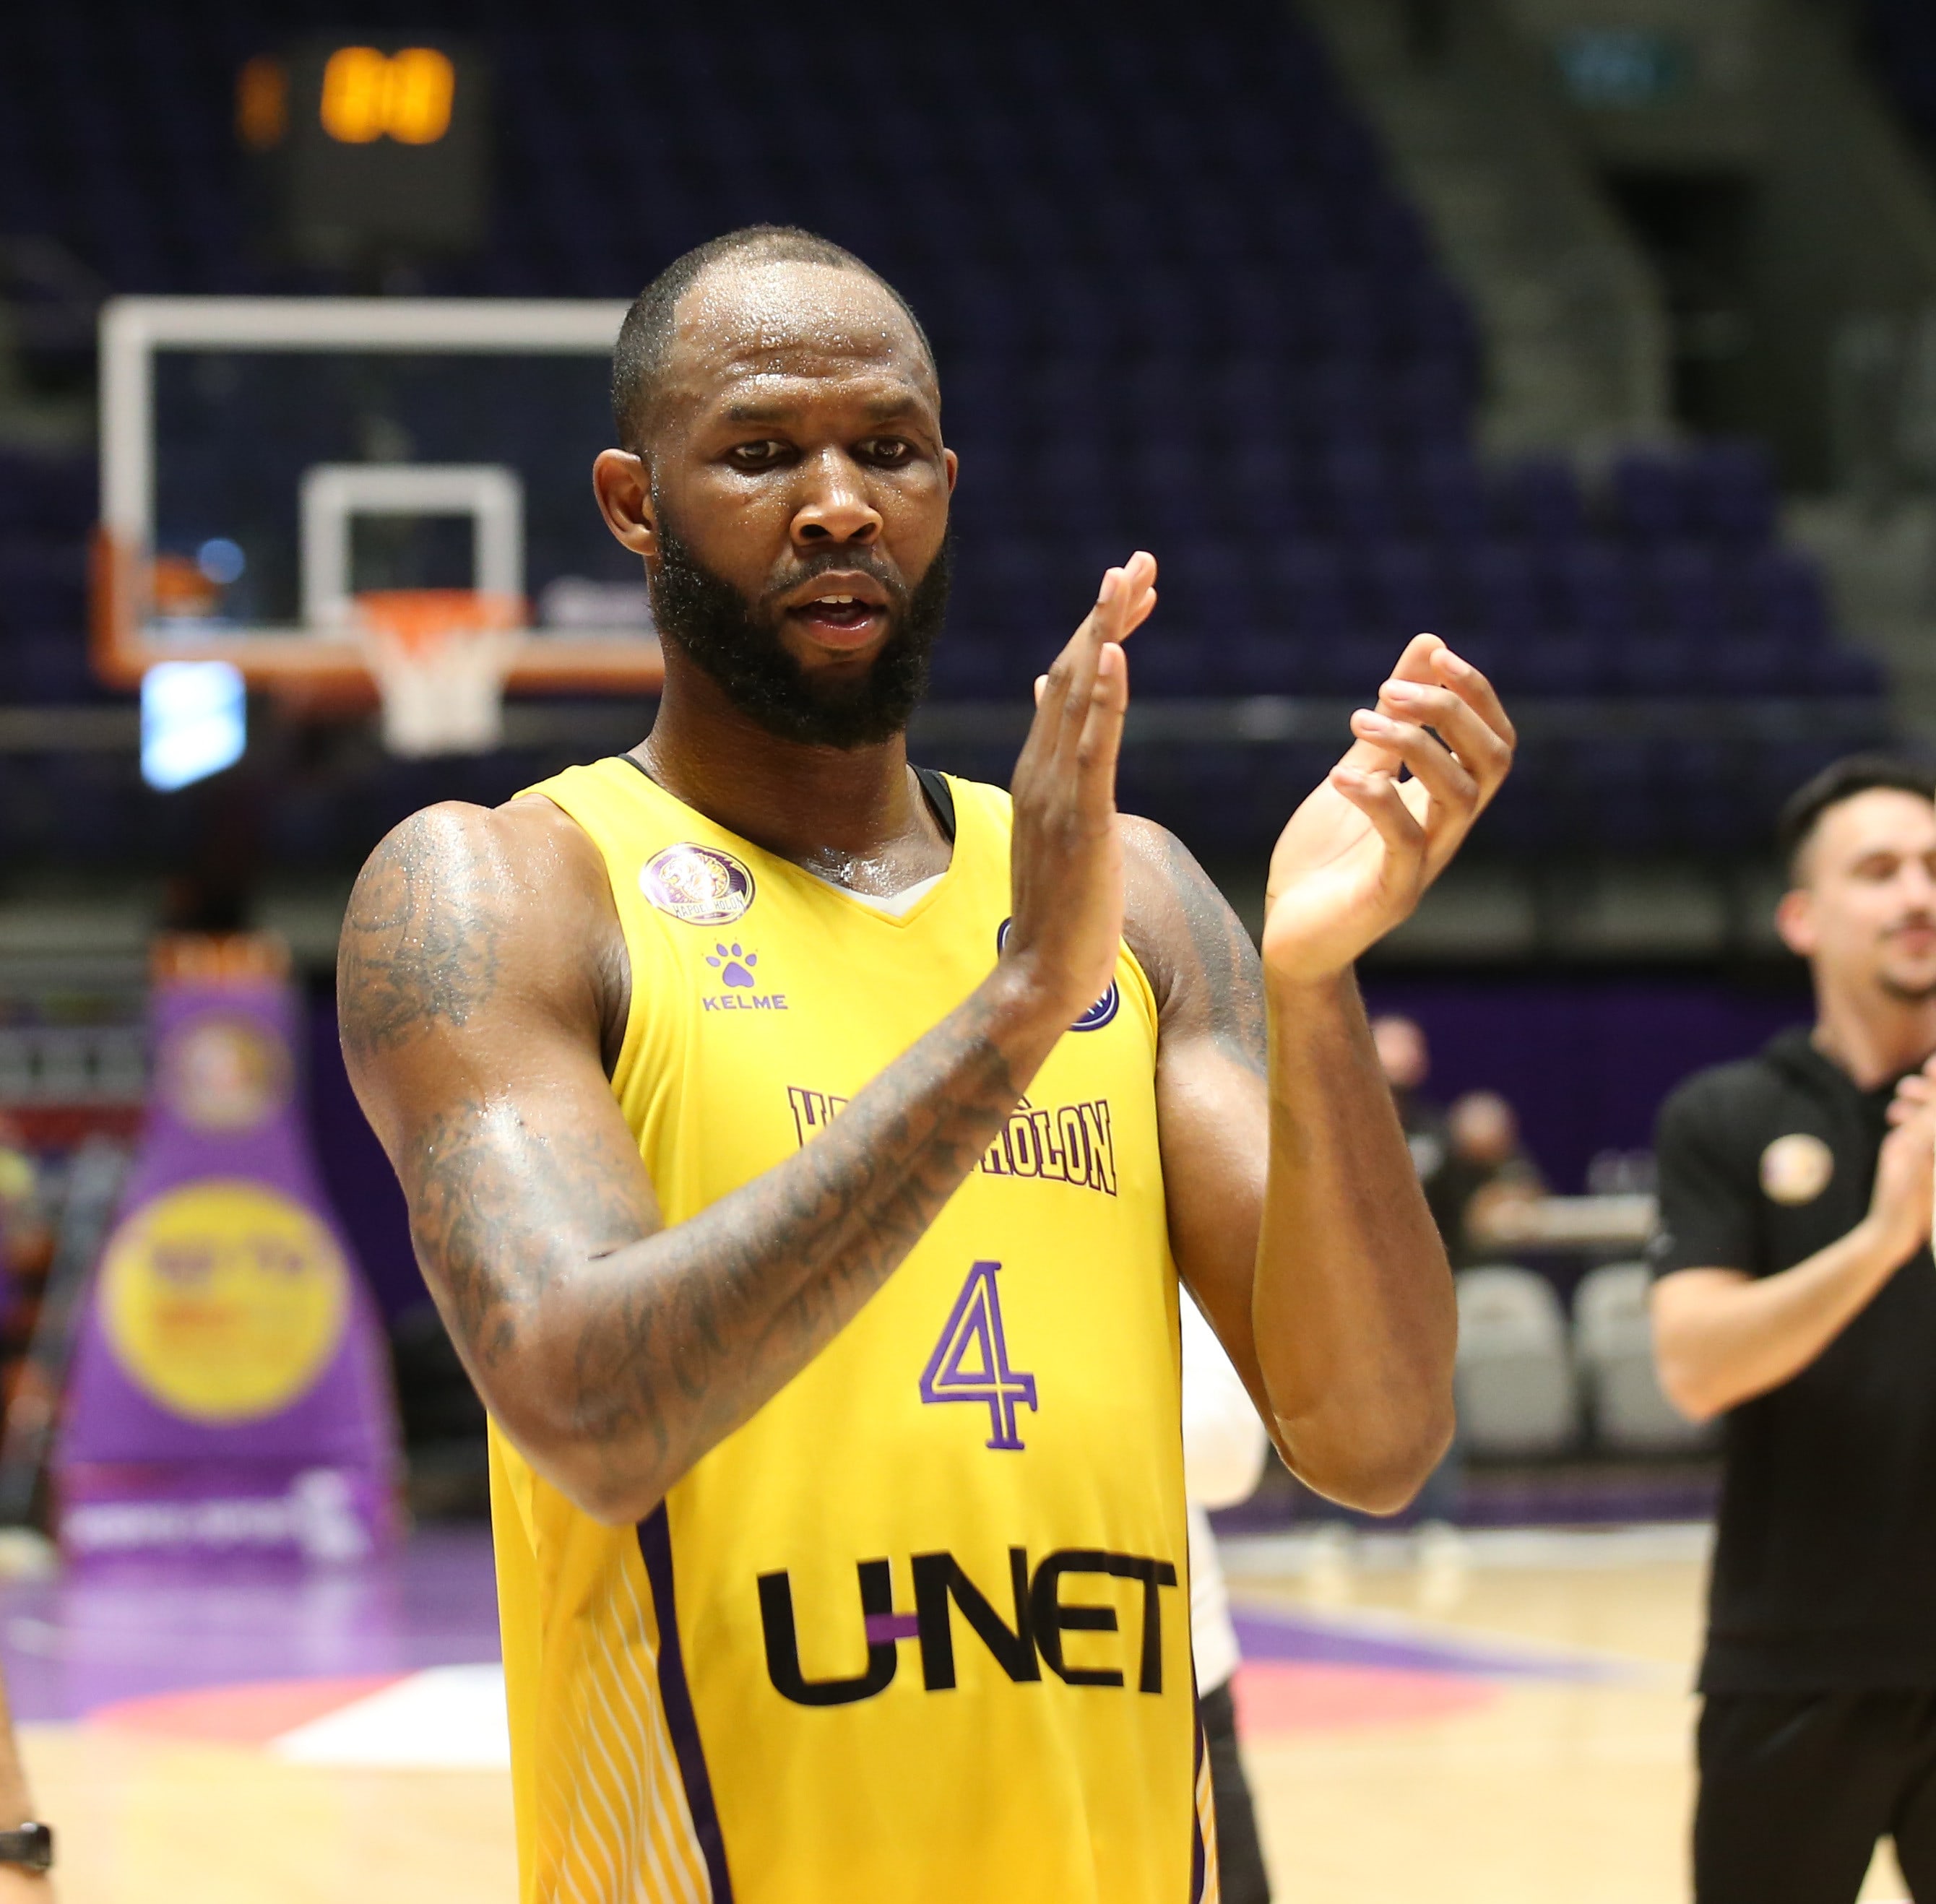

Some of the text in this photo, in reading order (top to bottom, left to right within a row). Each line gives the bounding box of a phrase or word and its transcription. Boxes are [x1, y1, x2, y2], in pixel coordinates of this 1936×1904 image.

[714, 894, 746, 910] HOLON
[702, 995, 788, 1011] KELME
[919, 1260, 1037, 1450] 4
